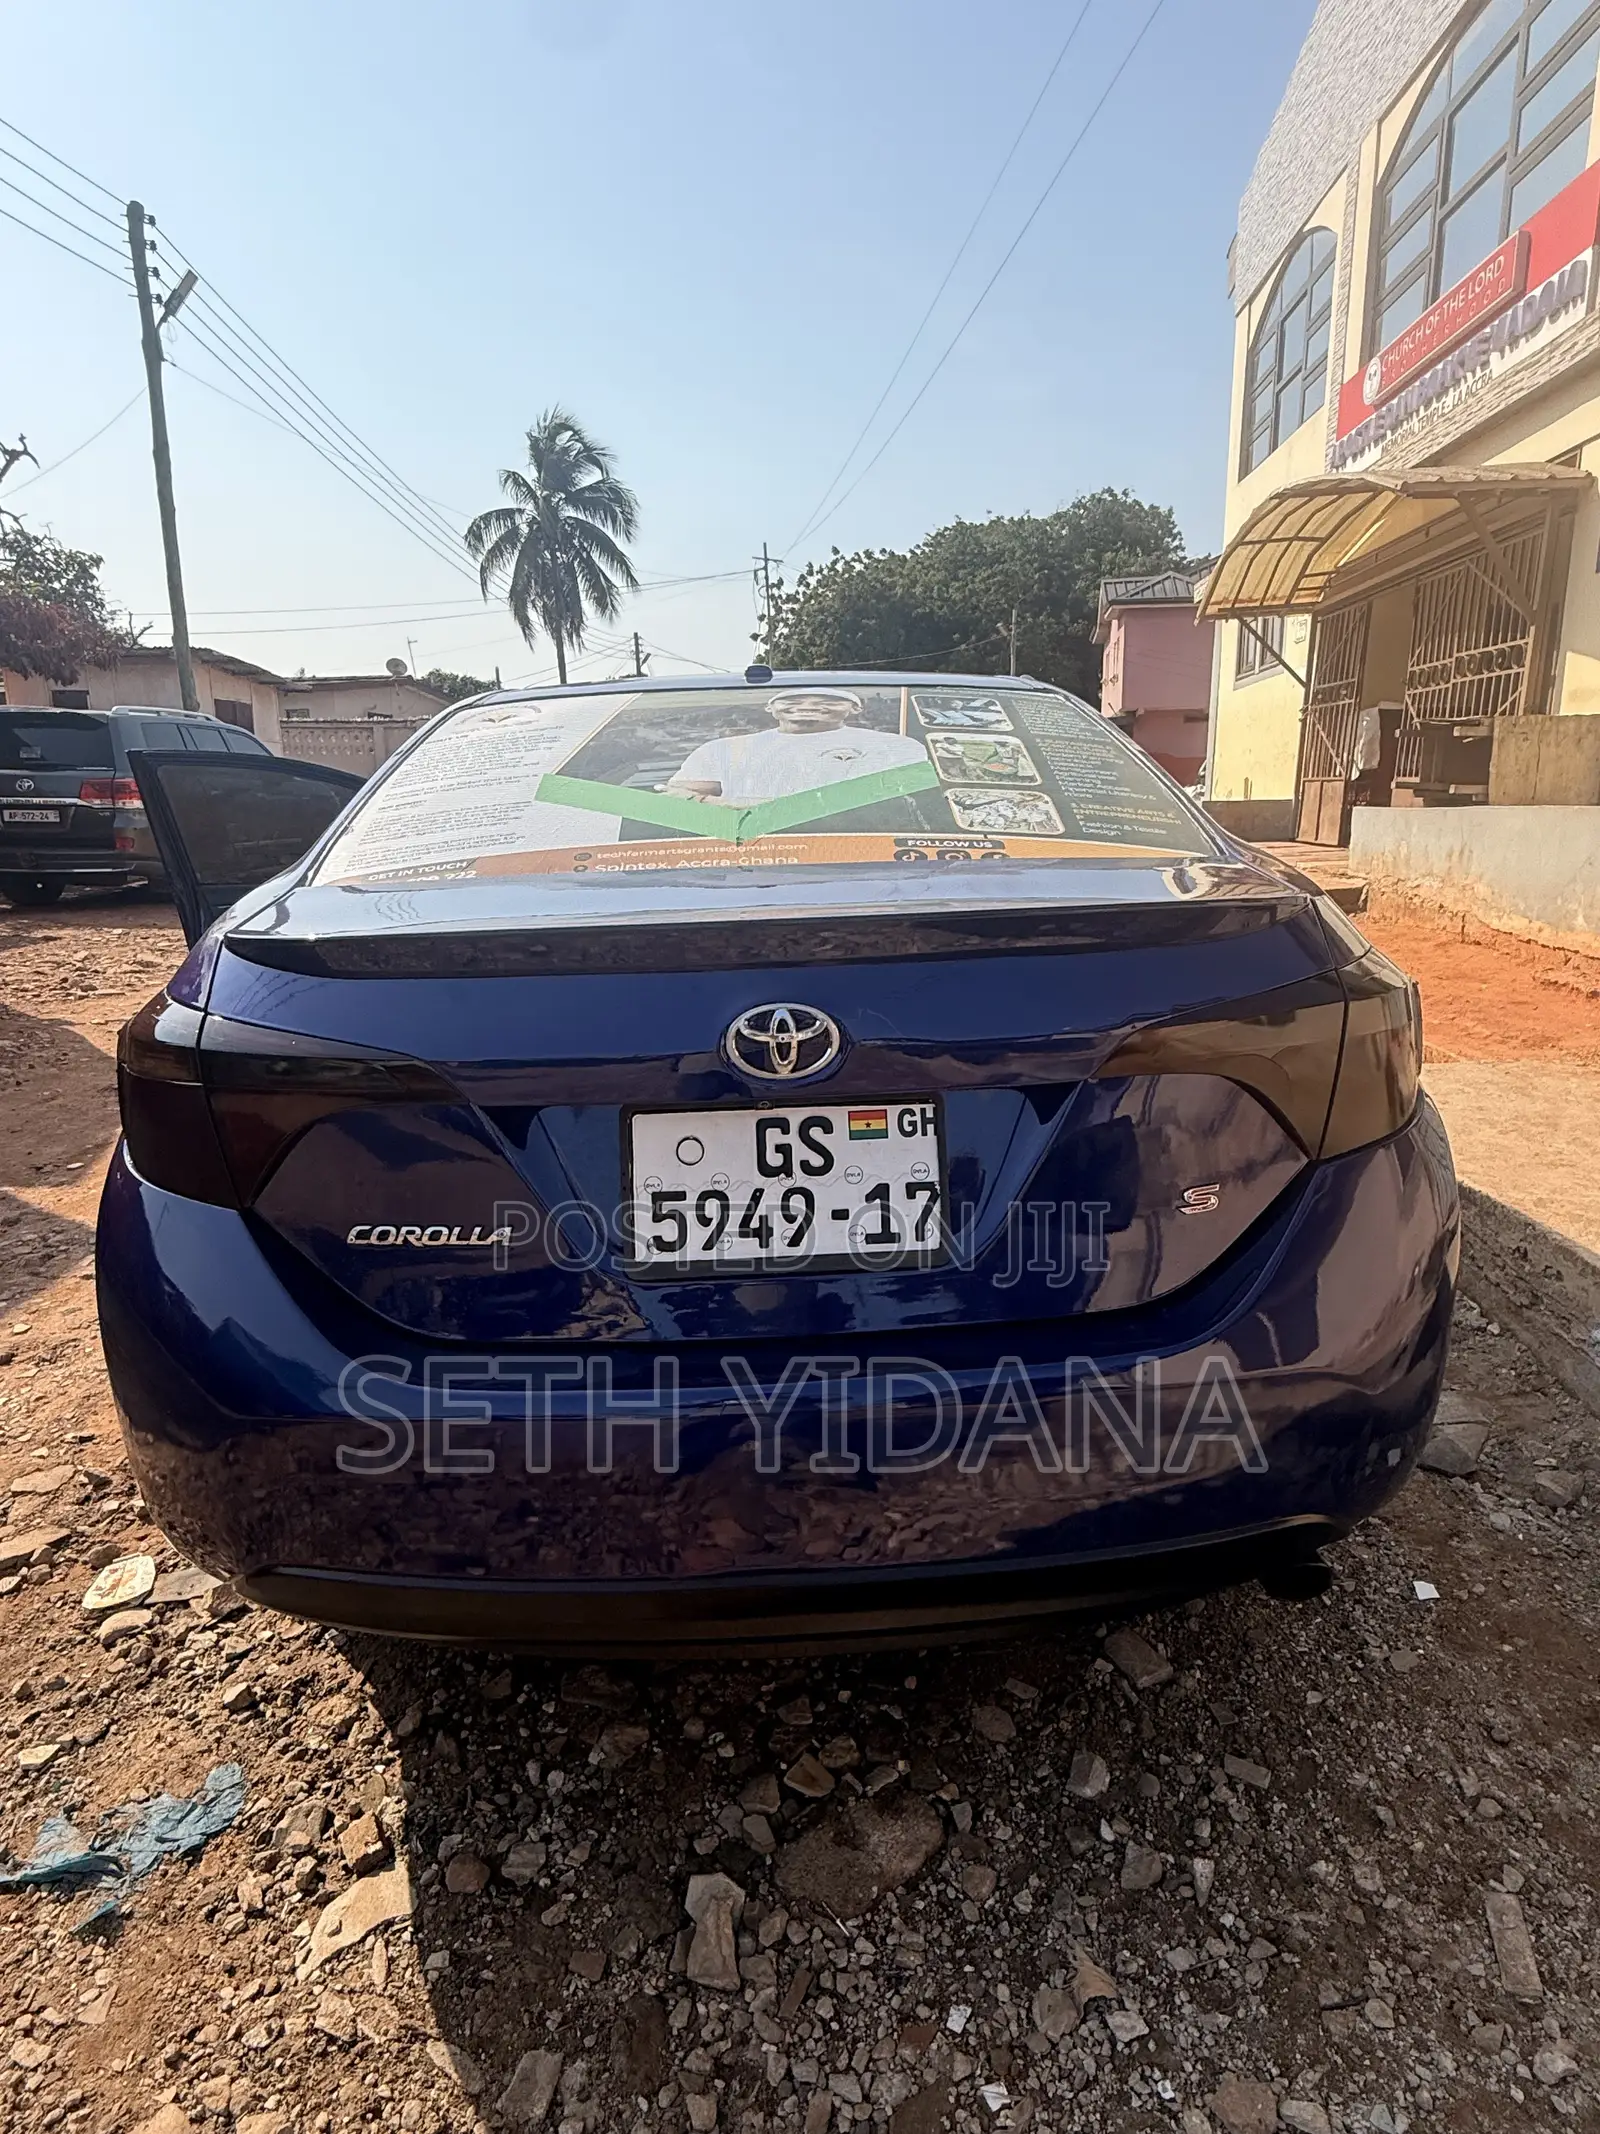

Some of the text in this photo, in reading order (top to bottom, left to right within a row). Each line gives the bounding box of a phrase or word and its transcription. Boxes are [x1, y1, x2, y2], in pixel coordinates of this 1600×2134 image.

[1382, 255, 1505, 372] CHURCH OF THE LORD
[1418, 401, 1447, 432] TEMPLE
[1464, 368, 1494, 402] ACCRA
[1080, 803, 1135, 813] CREATIVE
[1079, 820, 1122, 829] Fashion
[1083, 827, 1122, 836] Design
[907, 839, 993, 848] FOLLOW US
[398, 868, 413, 877] IN
[418, 861, 468, 872] TOUCH
[675, 856, 799, 869] Accra-Ghana
[756, 1107, 938, 1178] GS GH
[1180, 1183, 1220, 1214] S
[346, 1225, 513, 1247] COROLLA
